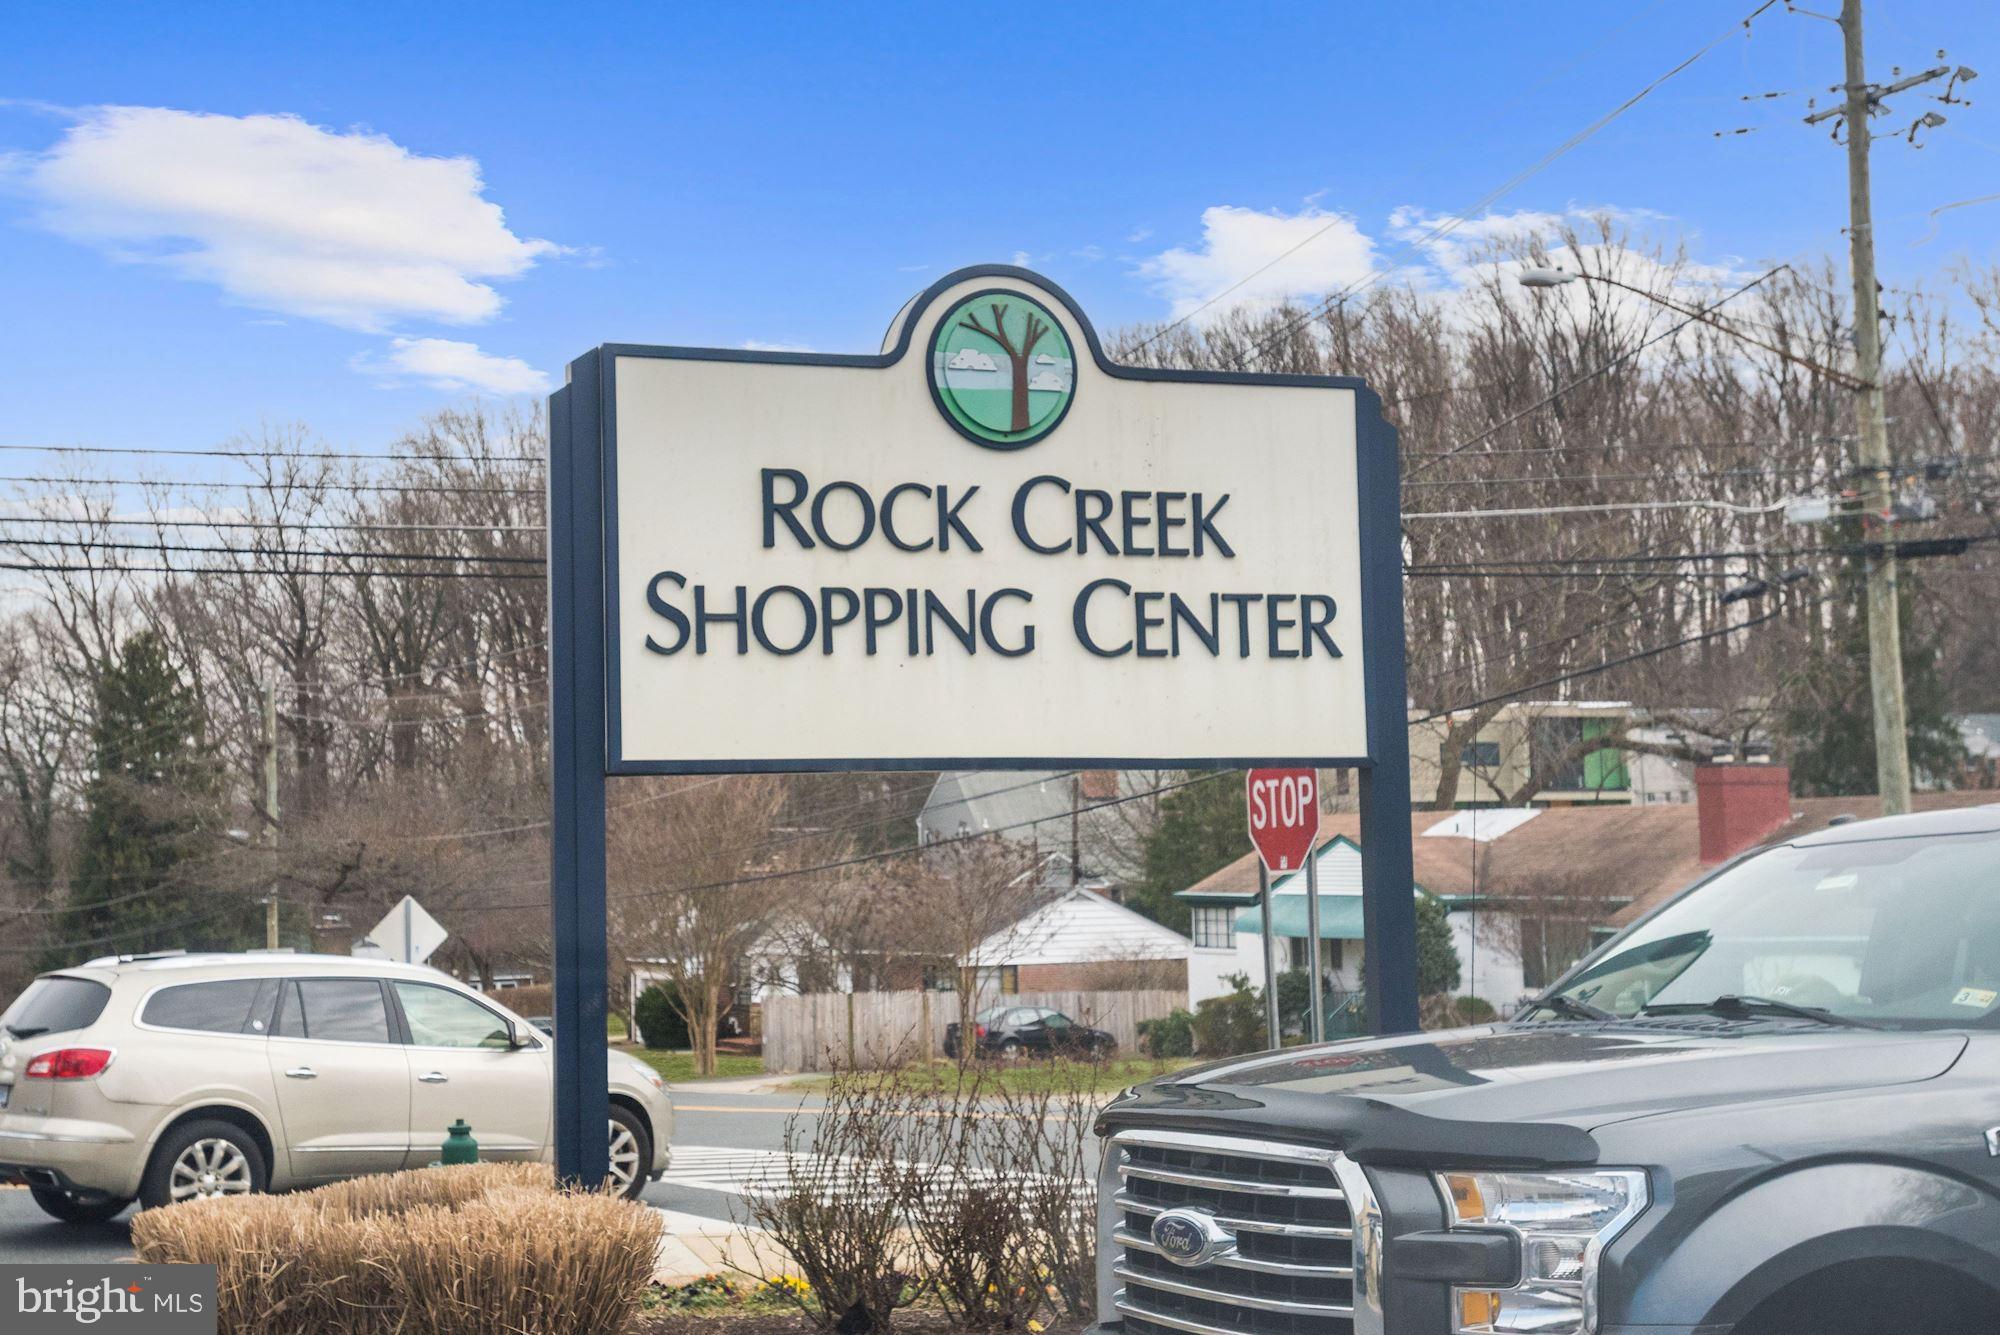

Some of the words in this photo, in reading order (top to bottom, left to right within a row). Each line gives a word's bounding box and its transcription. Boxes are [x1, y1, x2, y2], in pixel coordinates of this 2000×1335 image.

[760, 467, 984, 554] ROCK
[1010, 474, 1236, 560] CREEK
[644, 570, 1036, 659] SHOPPING
[1072, 577, 1344, 660] CENTER
[1252, 775, 1315, 830] STOP
[1160, 1221, 1193, 1252] Ford
